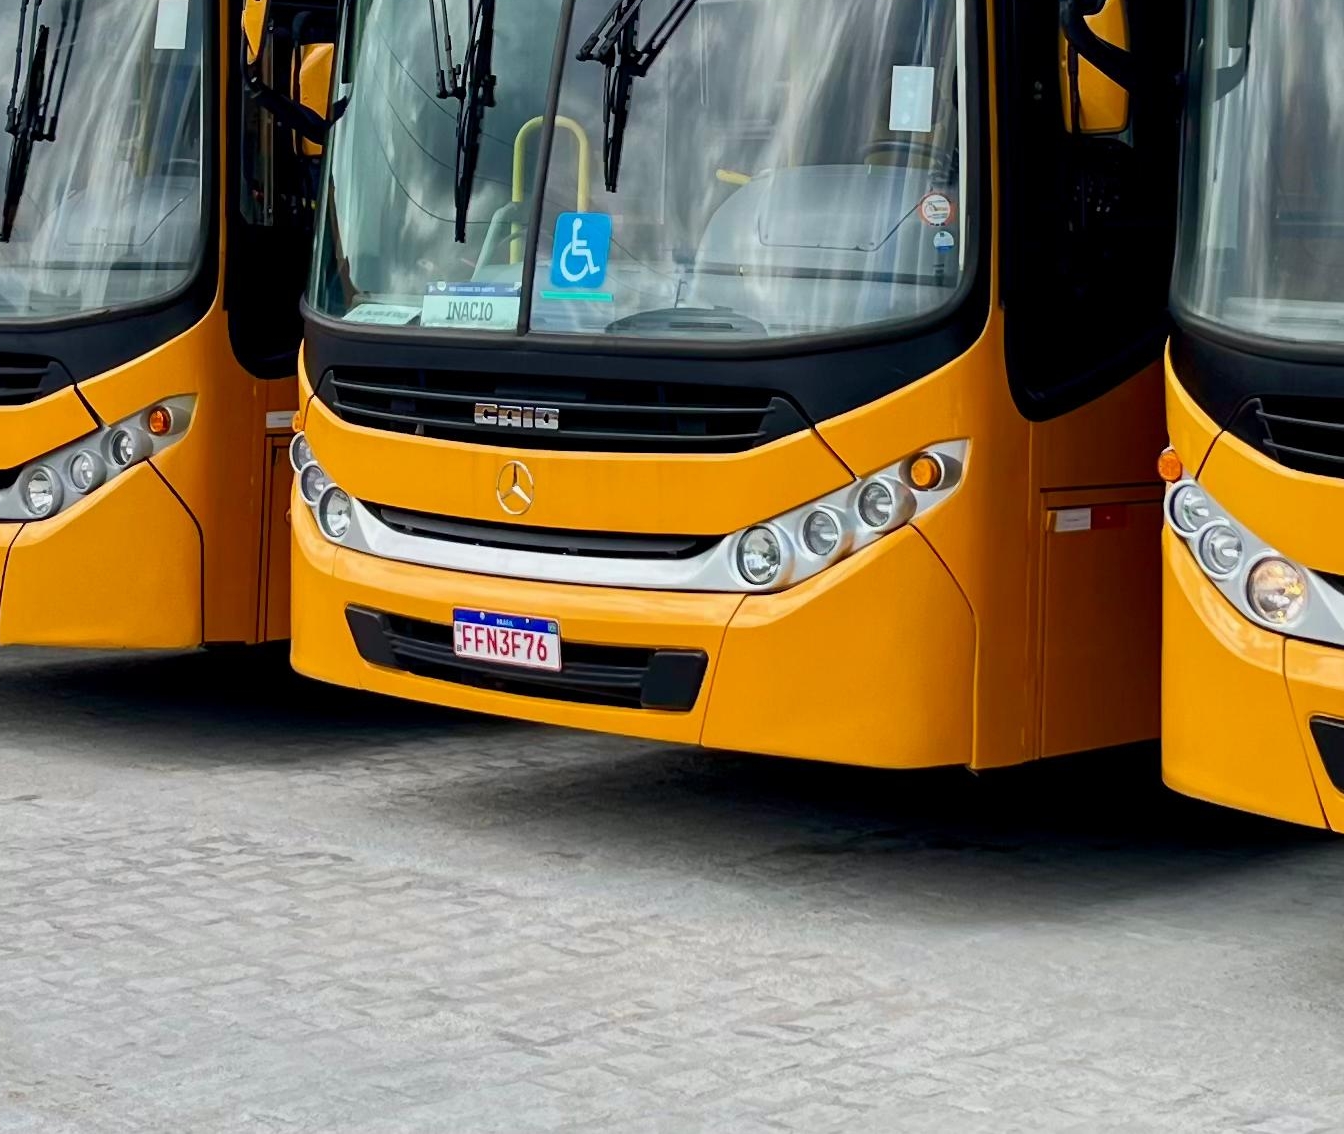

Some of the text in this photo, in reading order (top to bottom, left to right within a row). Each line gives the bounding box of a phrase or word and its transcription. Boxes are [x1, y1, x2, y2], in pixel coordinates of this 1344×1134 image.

[446, 301, 494, 322] INACIO
[474, 403, 560, 430] CAIO
[462, 624, 547, 662] FFN3F76
